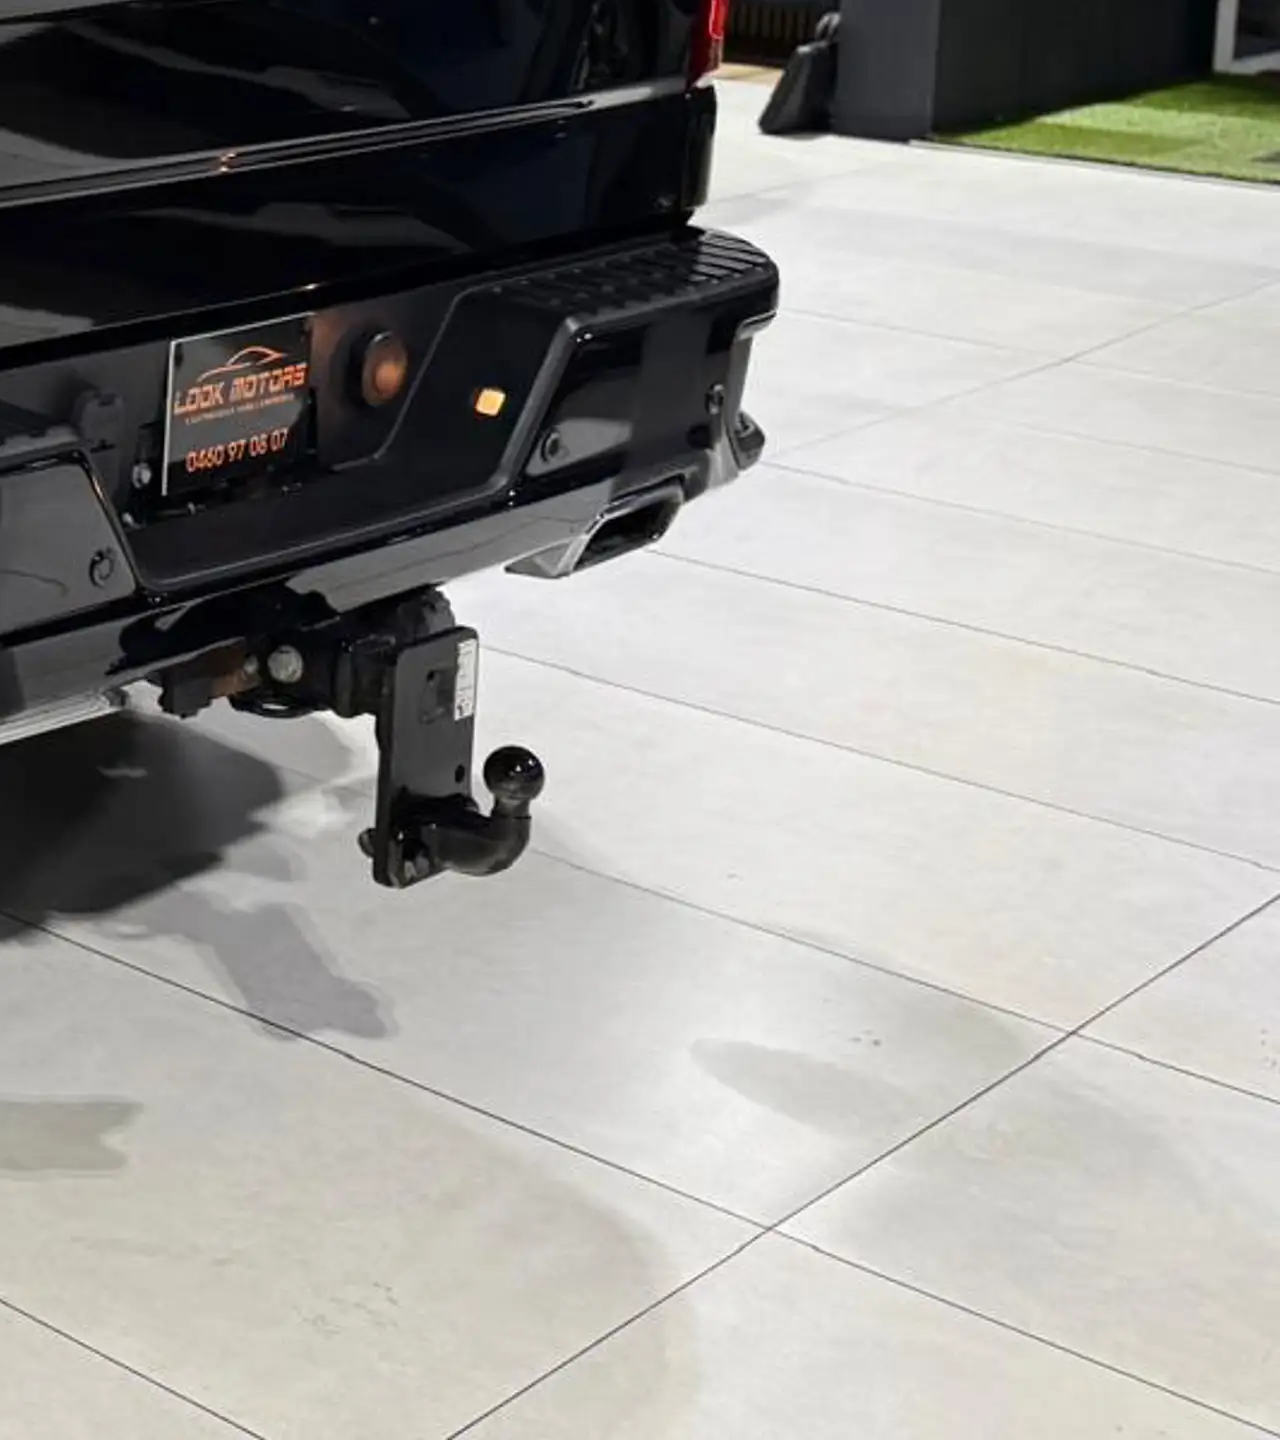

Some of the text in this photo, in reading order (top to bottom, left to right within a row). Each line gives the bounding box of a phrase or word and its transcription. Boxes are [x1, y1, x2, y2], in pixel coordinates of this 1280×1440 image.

[174, 381, 225, 415] LOOK
[228, 362, 308, 402] MOTORS
[226, 439, 246, 462] 97
[269, 427, 289, 451] 07
